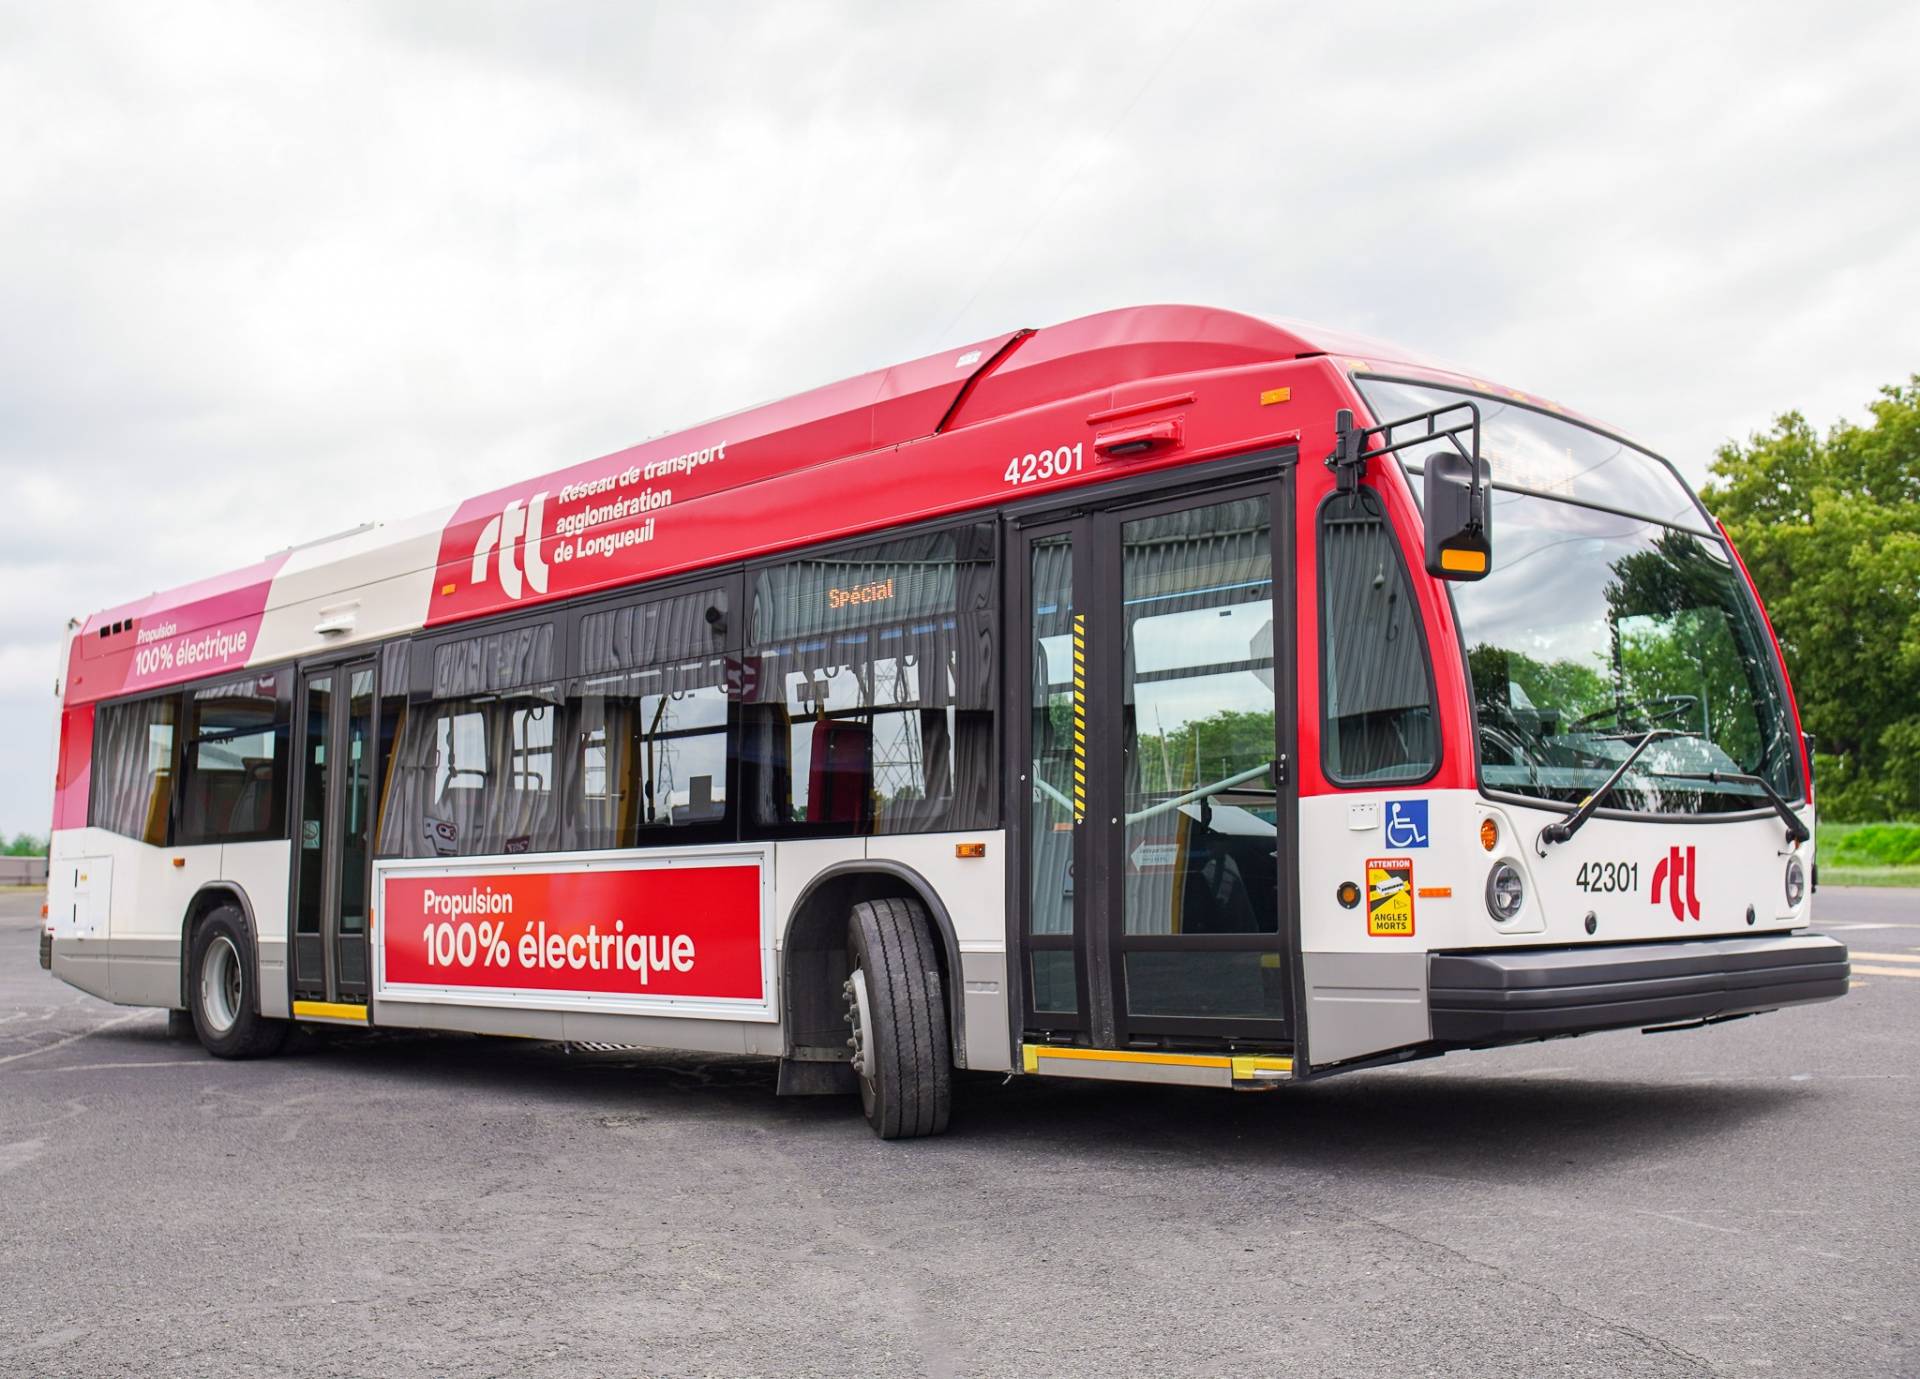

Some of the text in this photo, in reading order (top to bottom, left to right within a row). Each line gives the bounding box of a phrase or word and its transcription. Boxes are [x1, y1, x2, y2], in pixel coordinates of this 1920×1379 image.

[558, 440, 727, 504] Réseau de transport
[1004, 442, 1083, 485] 42301
[556, 488, 672, 537] agglomération
[471, 490, 550, 600] rtl
[554, 518, 655, 564] de Longueuil
[829, 578, 894, 608] Spécial
[136, 622, 177, 645] Propulsion
[136, 630, 247, 676] 100% électrique
[1369, 860, 1410, 868] ATTENTION
[1576, 861, 1639, 893] 42301
[1650, 845, 1701, 922] rtl
[424, 887, 513, 921] Propulsion
[1374, 913, 1408, 921] ANGLES
[1376, 922, 1407, 930] MORTS
[423, 920, 695, 985] 100% électrique
